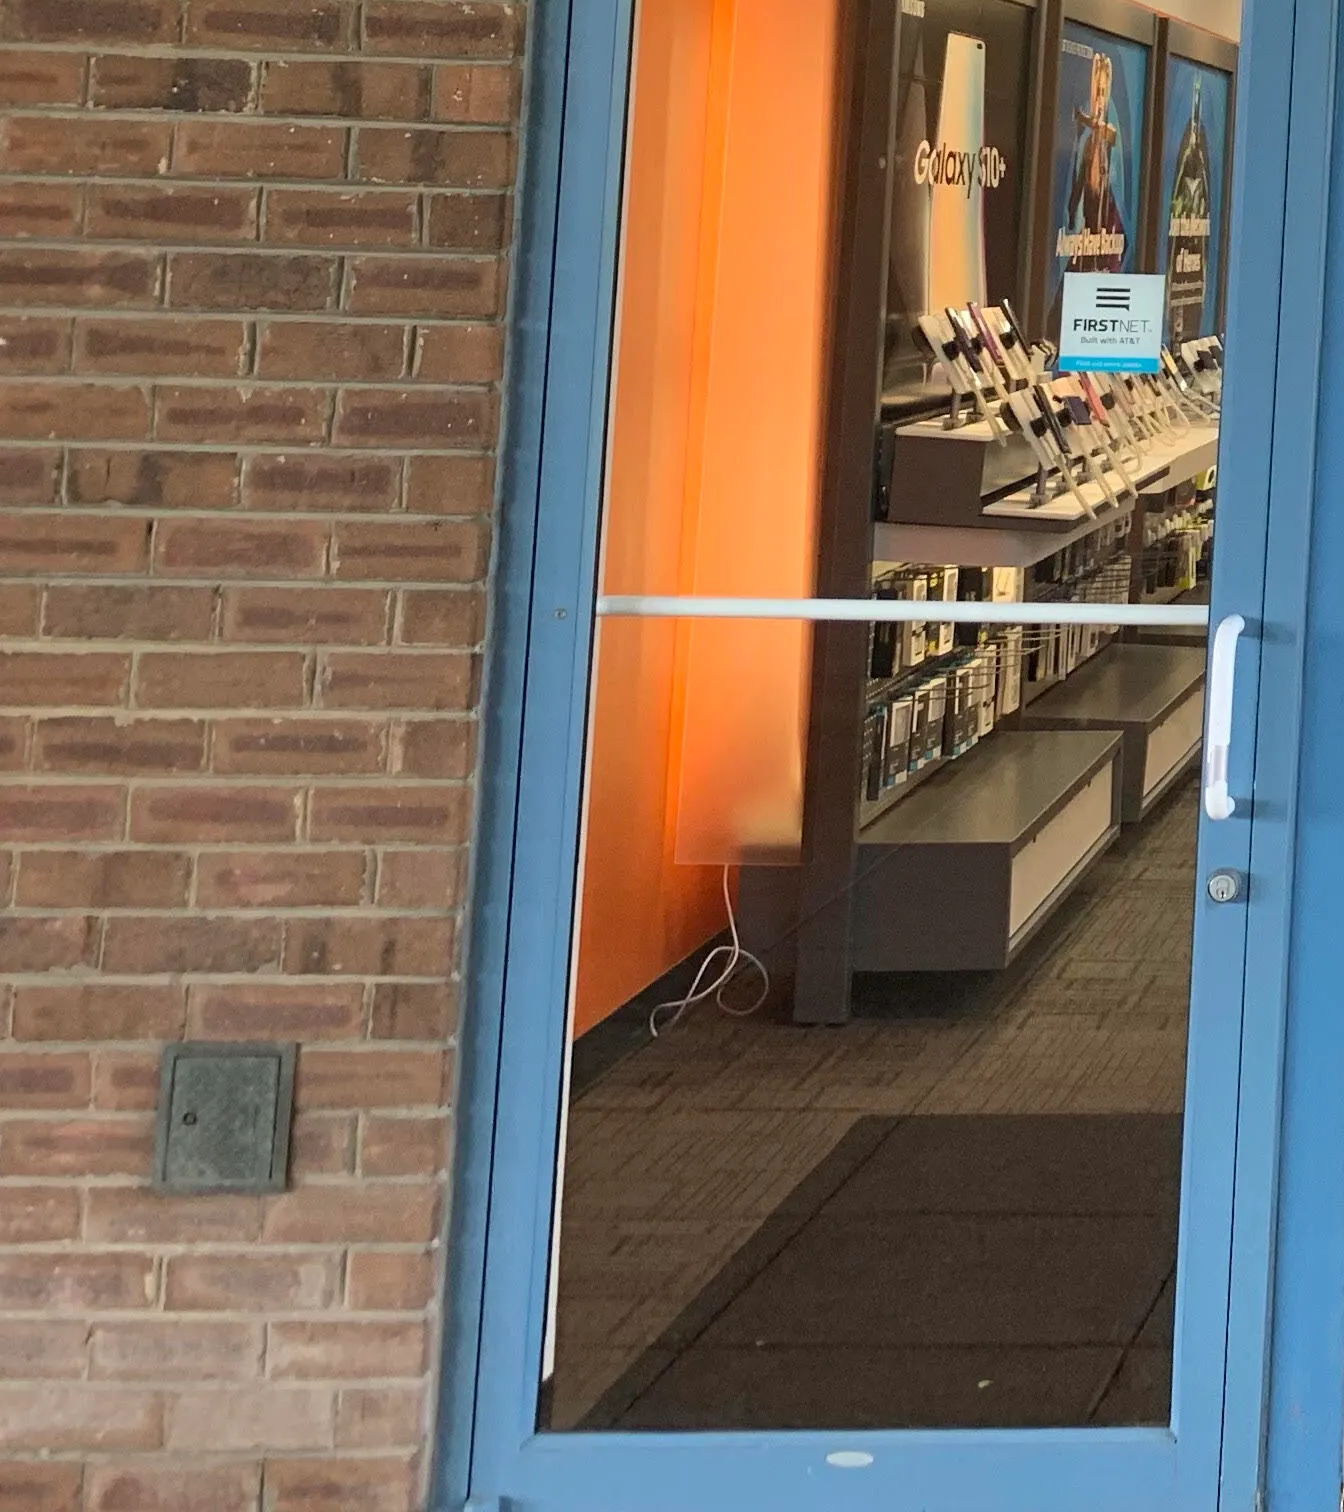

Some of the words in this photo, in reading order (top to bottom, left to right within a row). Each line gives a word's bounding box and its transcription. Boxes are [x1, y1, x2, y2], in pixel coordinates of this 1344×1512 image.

[914, 140, 976, 199] Galaxy
[977, 146, 1006, 188] S10+
[1080, 337, 1098, 345] Built
[1100, 337, 1117, 345] with
[1119, 337, 1141, 345] AT&T
